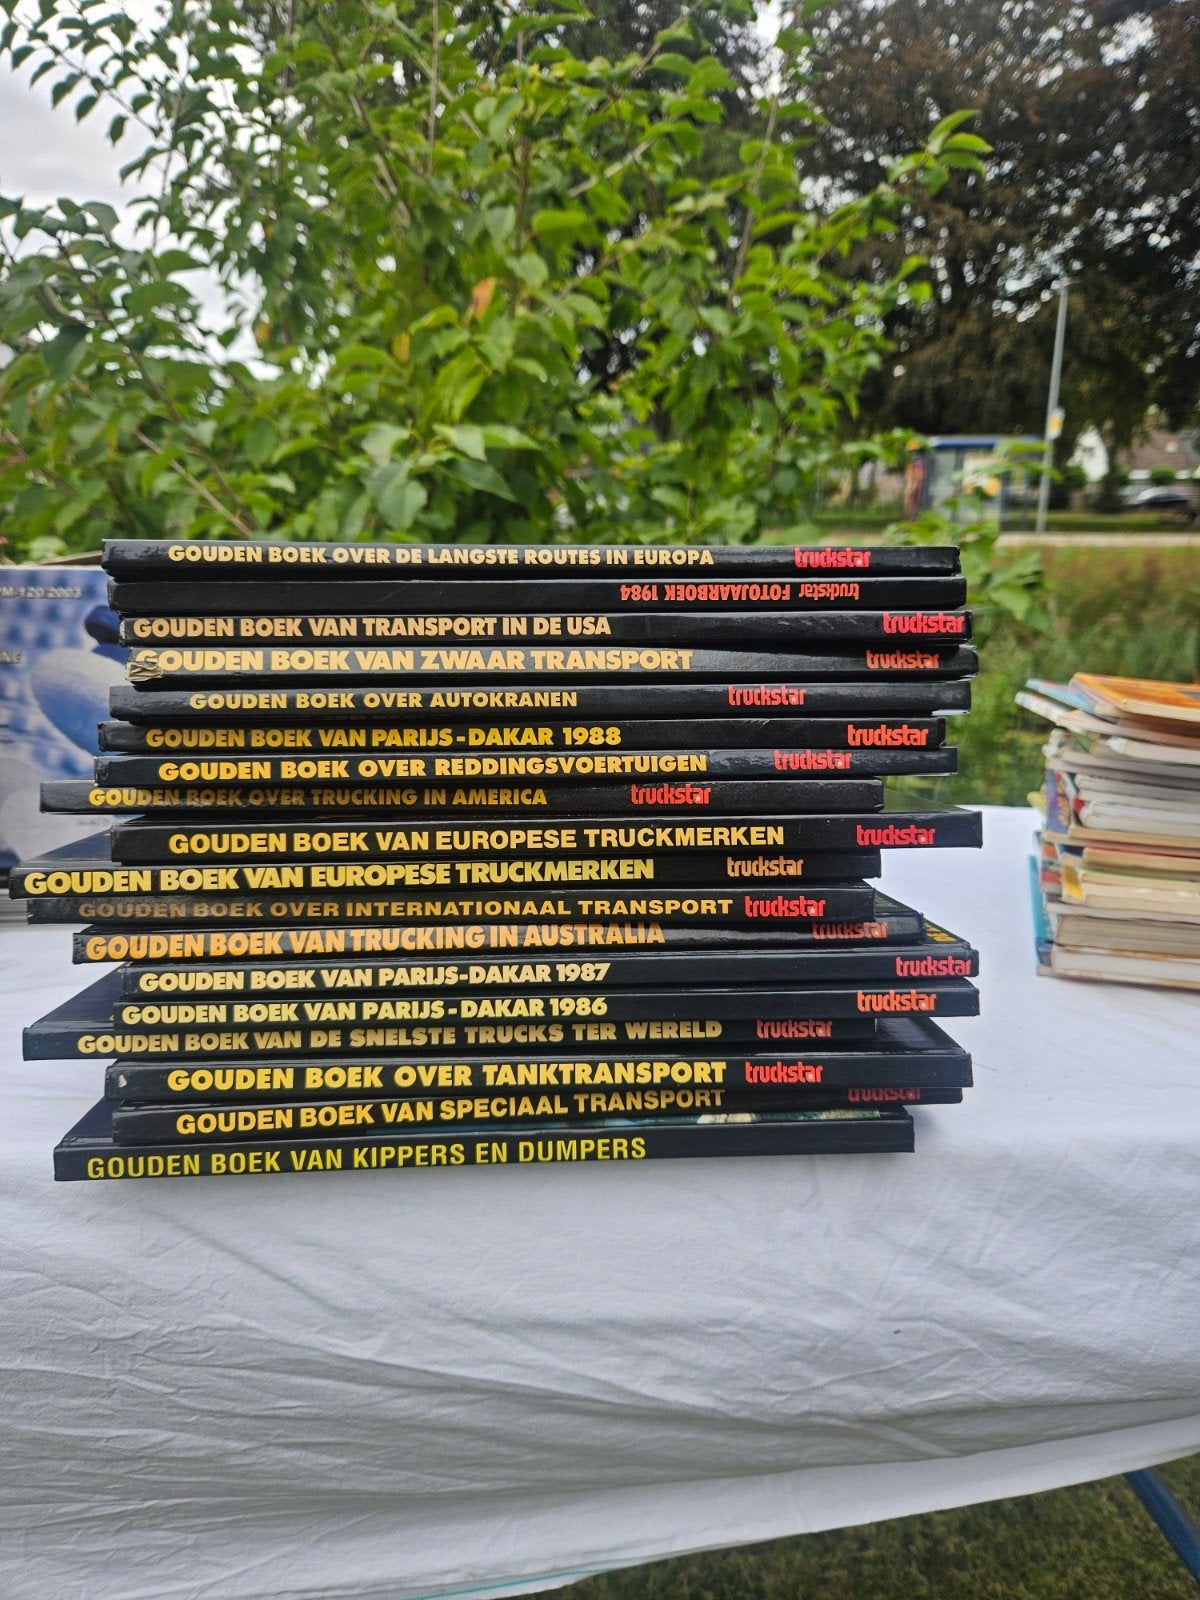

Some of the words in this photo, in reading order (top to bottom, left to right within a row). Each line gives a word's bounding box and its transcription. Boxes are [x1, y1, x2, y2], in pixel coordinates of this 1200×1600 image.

[168, 546, 262, 563] GOUDEN
[269, 547, 327, 563] BOEK
[333, 548, 390, 564] OVER
[396, 549, 422, 564] DE
[428, 549, 519, 565] LANGSTE
[525, 550, 601, 565] ROUTES
[606, 550, 627, 565] IN
[634, 550, 714, 565] EUROPA
[795, 547, 870, 569] truckstar
[621, 584, 658, 600] 1984
[665, 584, 790, 600] FOTOJAARBOEK
[799, 583, 859, 600] truckstar
[133, 618, 234, 637] GOUDEN
[240, 618, 303, 636] BOEK
[308, 618, 357, 636] VAN
[363, 618, 497, 636] TRANSPORT
[503, 617, 528, 635] IN
[534, 617, 561, 635] DE
[567, 617, 611, 636] USA
[883, 613, 963, 633] truckstar
[271, 650, 349, 670] BOEK
[353, 650, 414, 670] VAN
[421, 650, 525, 670] ZWAAR
[531, 650, 693, 670] TRANSPORT
[866, 650, 939, 669] truckstar
[189, 693, 288, 709] GOUDEN
[296, 693, 355, 709] BOEK
[363, 693, 422, 709] OVER
[430, 692, 578, 708] AUTOKRANEN
[729, 686, 805, 705] truckstar
[146, 730, 245, 747] GOUDEN
[251, 730, 312, 747] BOEK
[318, 730, 366, 747] VAN
[562, 727, 621, 745] 1988
[848, 725, 928, 745] truckstar
[159, 763, 271, 780] GOUDEN
[281, 761, 349, 778] BOEK
[358, 760, 426, 778] OVER
[435, 755, 707, 776] REDDINGSVOERTUIGEN
[774, 750, 851, 770] truckstar
[89, 790, 180, 806] GOUDEN
[185, 790, 241, 806] BOEK
[248, 789, 305, 806] OVER
[311, 789, 418, 806] TRUCKING
[423, 789, 446, 805] IN
[452, 789, 547, 805] AMERICA
[631, 784, 711, 804] truckstar
[170, 833, 287, 853] GOUDEN
[293, 833, 368, 853] BOEK
[377, 832, 429, 851] VAN
[436, 829, 577, 850] EUROPESE
[584, 827, 784, 848] TRUCKMERKEN
[856, 825, 935, 845] truckstar
[24, 870, 152, 894] GOUDEN
[161, 868, 238, 891] BOEK
[241, 867, 304, 889] VAN
[310, 864, 450, 887] EUROPESE
[455, 859, 655, 884] TRUCKMERKEN
[727, 856, 803, 878] truckstar
[79, 903, 188, 918] GOUDEN
[193, 903, 262, 918] BOEK
[270, 903, 339, 917] OVER
[346, 900, 571, 917] INTERNATIONAAL
[580, 899, 733, 915] TRANSPORT
[745, 896, 825, 917] truckstar
[812, 921, 887, 940] truckstar
[86, 935, 204, 960] GOUDEN
[210, 932, 283, 957] BOEK
[289, 931, 346, 954] VAN
[350, 926, 486, 951] TRUCKING
[490, 926, 518, 948] IN
[523, 923, 665, 946] AUSTRALIA
[895, 956, 972, 976] truckstar
[139, 972, 245, 992] GOUDEN
[250, 971, 316, 990] BOEK
[320, 968, 372, 988] VAN
[556, 962, 610, 982] 1987
[122, 1005, 227, 1024] GOUDEN
[234, 1004, 299, 1022] BOEK
[304, 1003, 356, 1021] VAN
[550, 997, 608, 1016] 1986
[857, 990, 936, 1011] truckstar
[78, 1035, 179, 1054] GOUDEN
[185, 1033, 249, 1052] BOEK
[255, 1031, 302, 1050] VAN
[311, 1030, 341, 1048] DE
[349, 1027, 456, 1047] SNELSTE
[465, 1024, 562, 1045] TRUCKS
[573, 1023, 617, 1041] TER
[625, 1021, 723, 1039] WERELD
[757, 1019, 832, 1038] truckstar
[168, 1069, 294, 1091] GOUDEN
[305, 1068, 383, 1088] BOEK
[394, 1066, 472, 1087] OVER
[483, 1062, 727, 1085] TANKTRANSPORT
[745, 1062, 823, 1083] truckstar
[177, 1110, 293, 1134] GOUDEN
[300, 1105, 374, 1129] BOEK
[382, 1102, 434, 1123] VAN
[440, 1094, 568, 1120] SPECIAAL
[574, 1089, 725, 1112] TRANSPORT
[88, 1156, 200, 1179] GOUDEN
[211, 1152, 281, 1175] BOEK
[290, 1150, 344, 1171] VAN
[354, 1144, 466, 1169] KIPPERS
[476, 1143, 508, 1164] EN
[519, 1138, 647, 1161] DUMPERS
